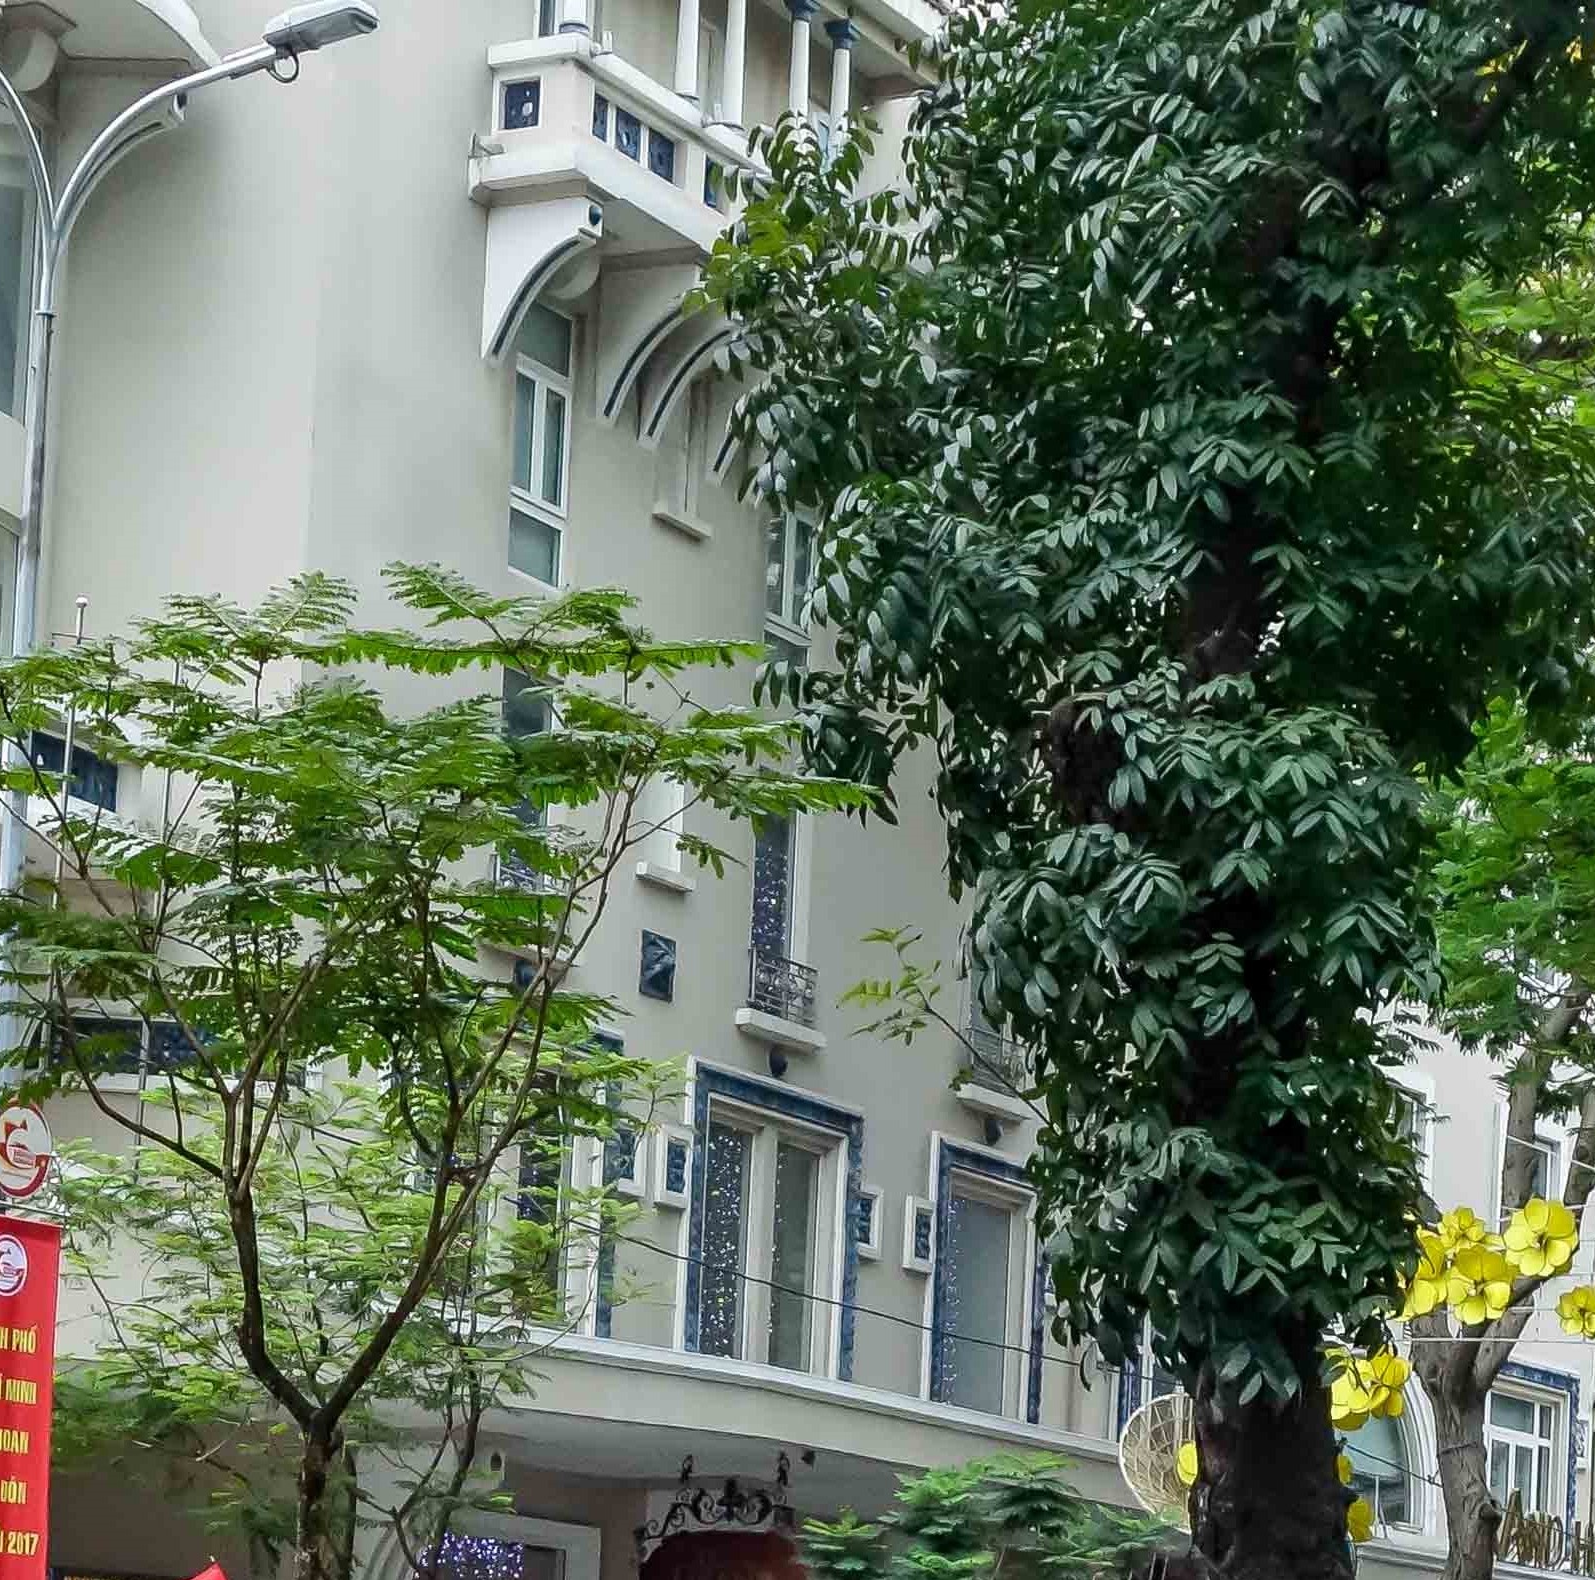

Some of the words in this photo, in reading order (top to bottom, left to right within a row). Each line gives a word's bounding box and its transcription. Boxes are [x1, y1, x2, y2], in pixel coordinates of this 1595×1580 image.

[11, 1322, 39, 1354] PHỐ
[5, 1378, 37, 1405] MINH
[5, 1531, 40, 1557] 2017
[1497, 1488, 1564, 1571] AND
